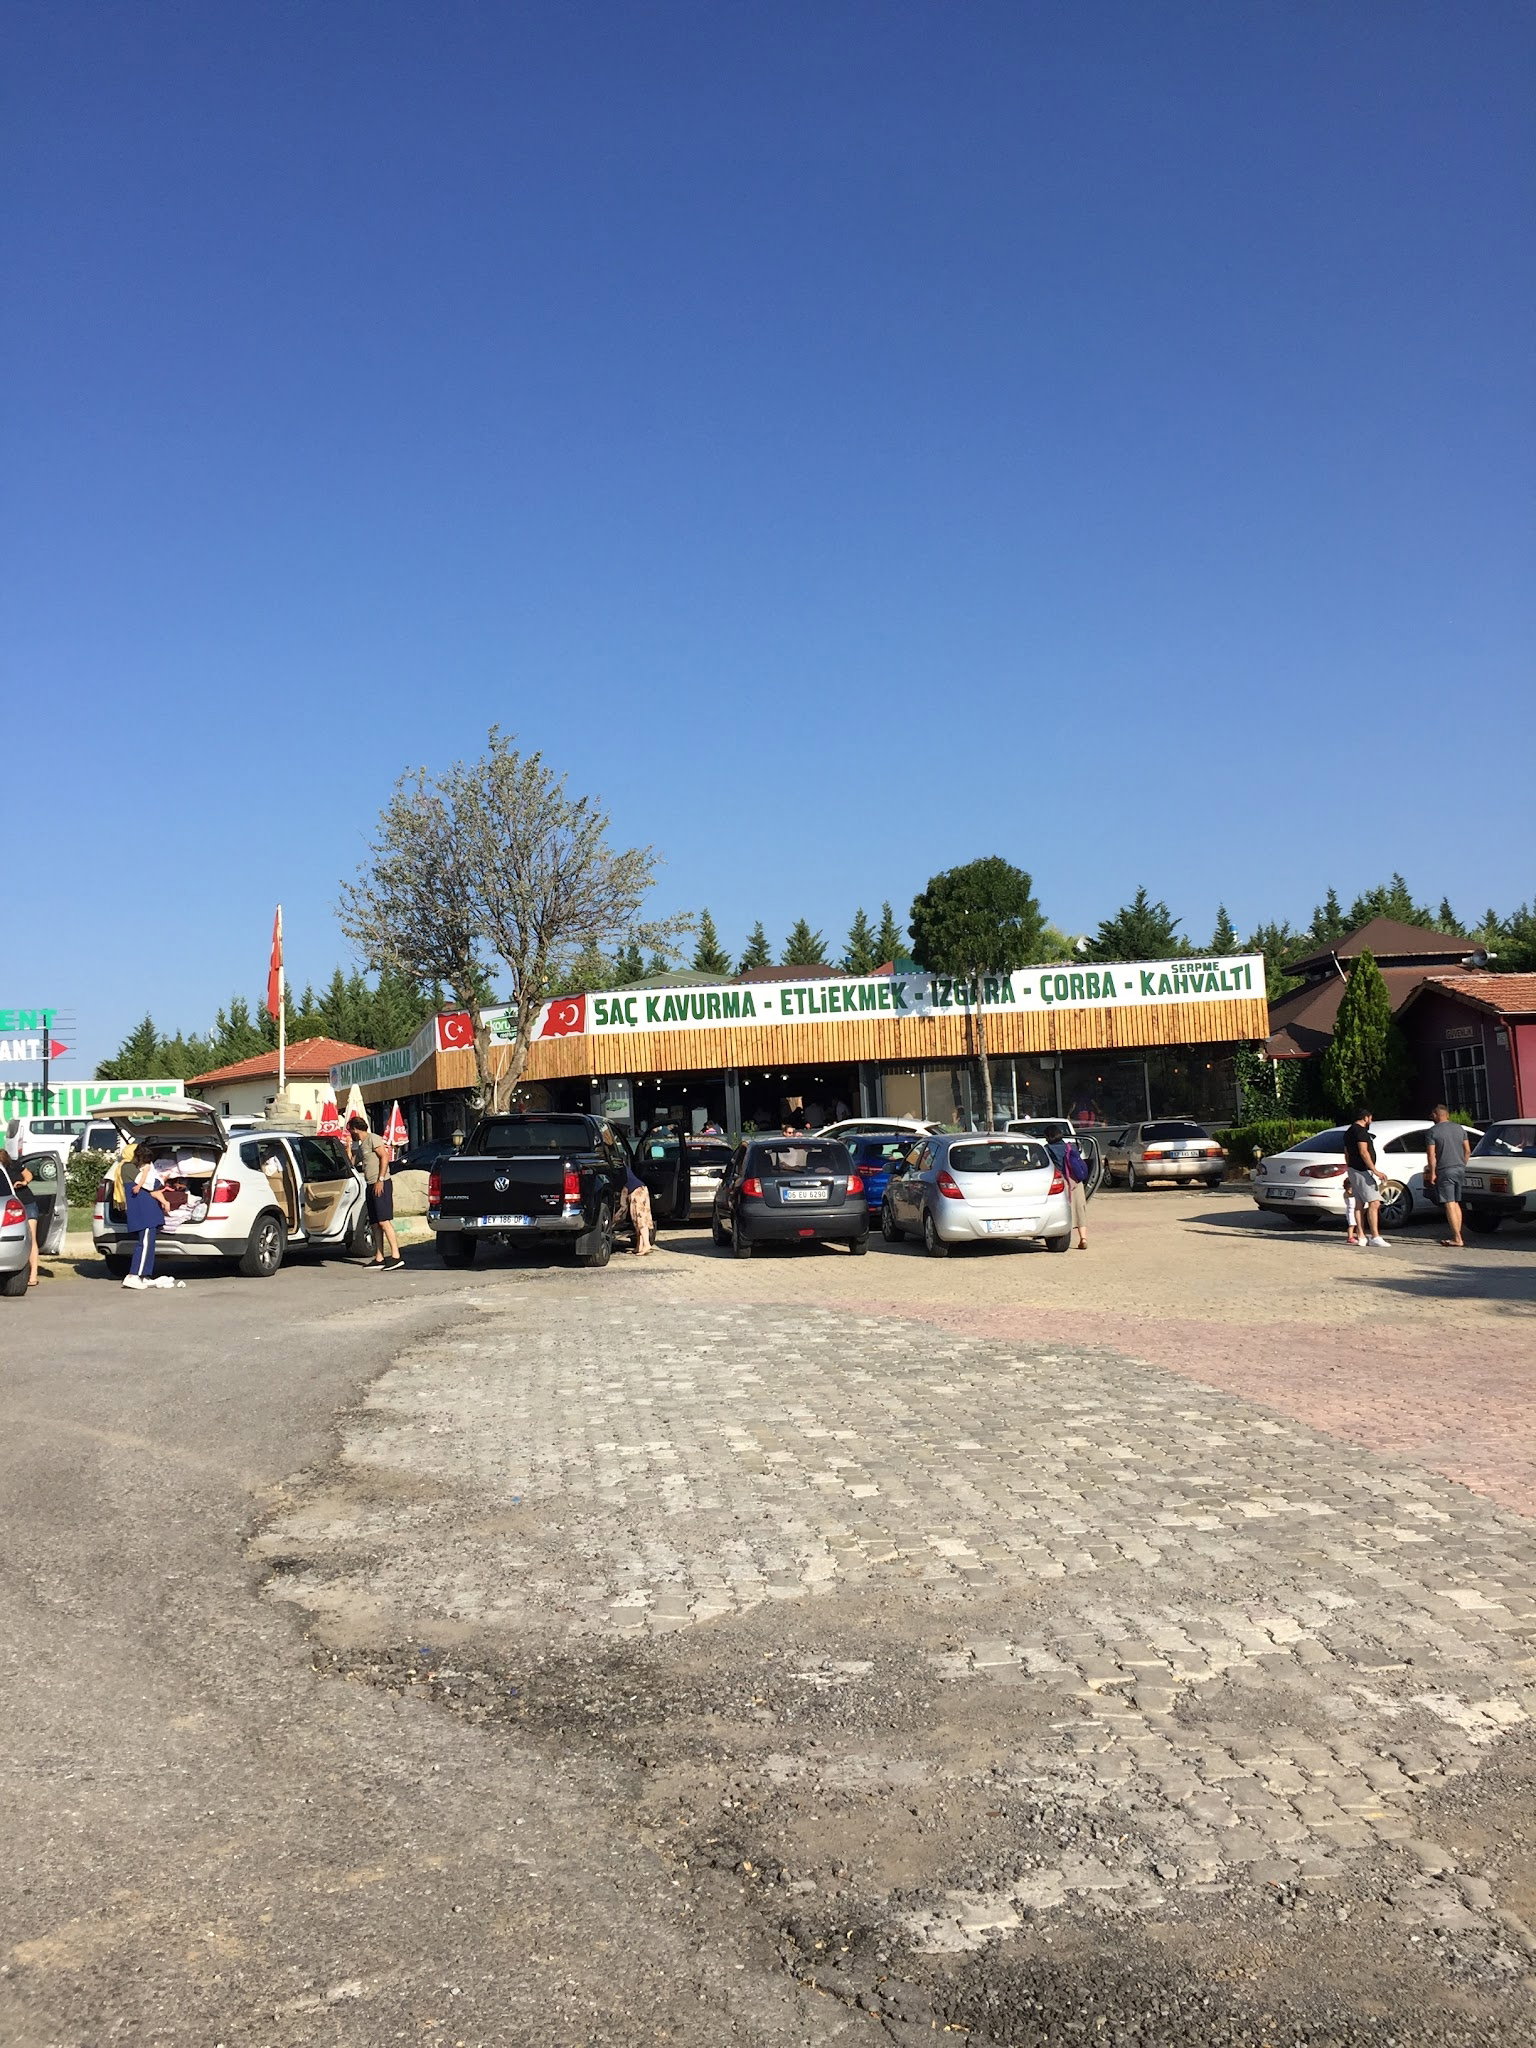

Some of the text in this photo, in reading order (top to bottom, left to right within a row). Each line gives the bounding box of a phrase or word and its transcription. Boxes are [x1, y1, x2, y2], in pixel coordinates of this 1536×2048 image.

[1171, 961, 1220, 974] SERPME
[594, 997, 638, 1027] SAÇ
[646, 991, 756, 1023] KAVURMA
[1040, 971, 1117, 1005] ÇORBA
[1140, 963, 1252, 996] KAHVALTI
